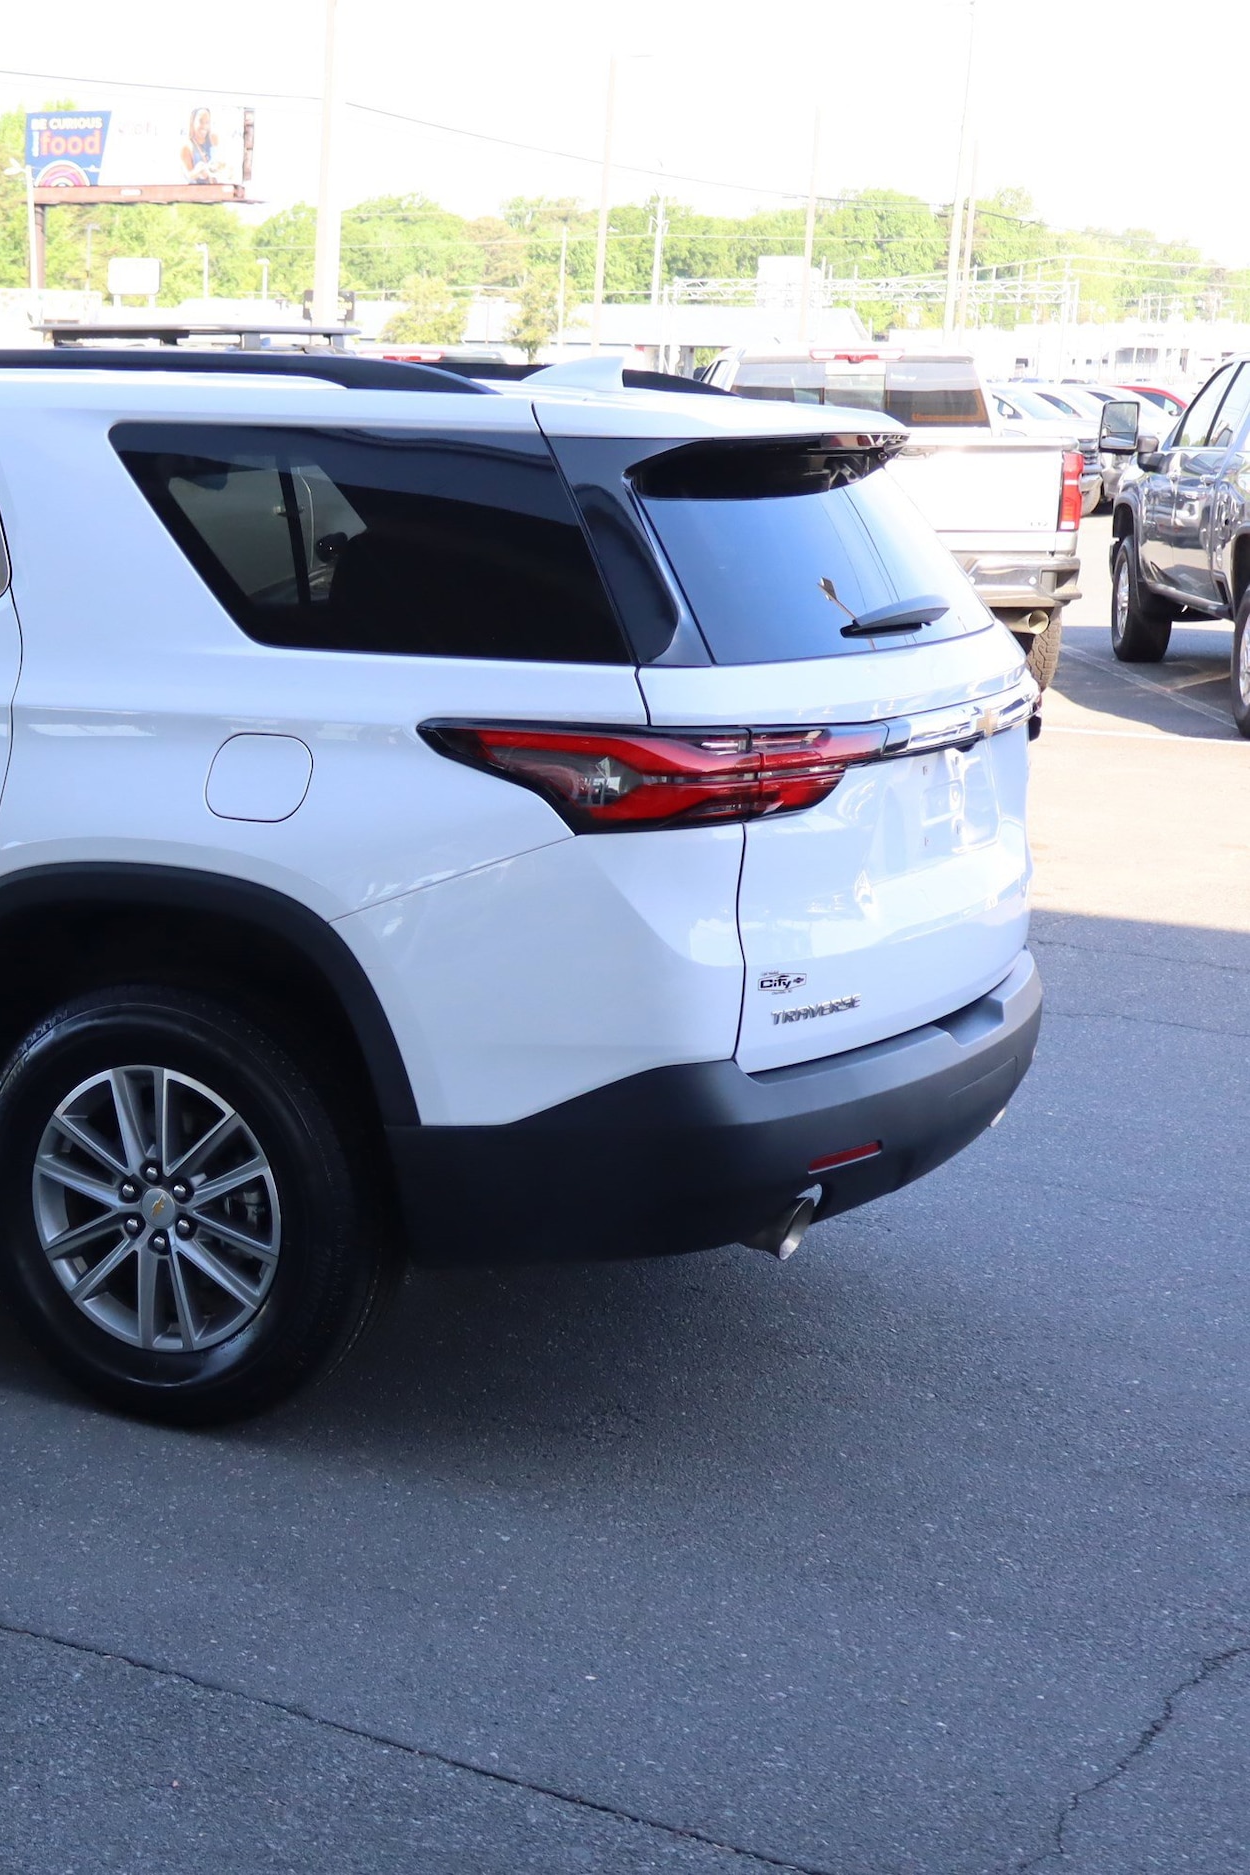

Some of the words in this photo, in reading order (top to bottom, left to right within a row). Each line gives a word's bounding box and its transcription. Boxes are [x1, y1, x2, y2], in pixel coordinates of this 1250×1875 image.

[31, 117, 48, 130] BE
[49, 116, 103, 130] CURIOUS
[40, 129, 102, 156] food
[770, 993, 862, 1026] TRAVERSE
